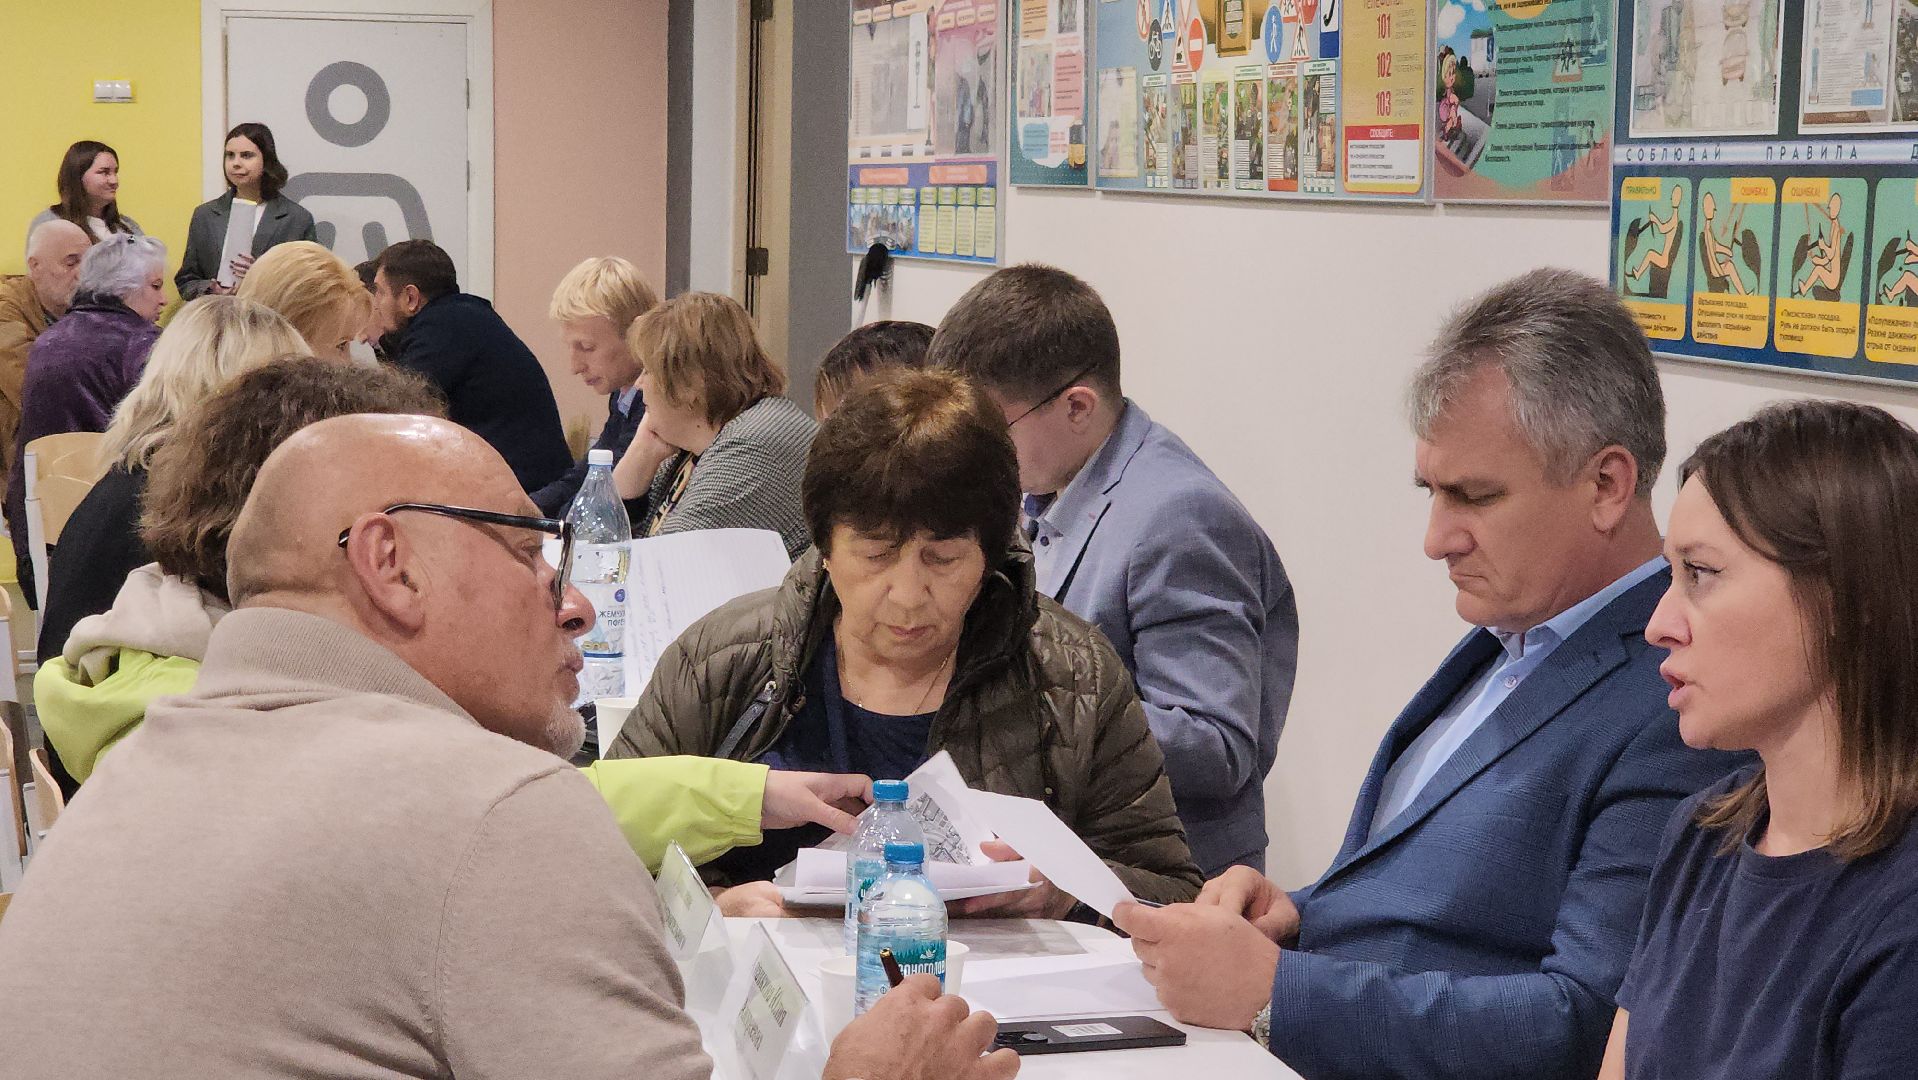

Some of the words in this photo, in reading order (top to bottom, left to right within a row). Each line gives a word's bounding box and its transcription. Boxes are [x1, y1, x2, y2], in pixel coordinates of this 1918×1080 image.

[1376, 13, 1391, 40] 101
[1376, 52, 1392, 78] 102
[1376, 90, 1392, 116] 103
[1626, 144, 1721, 162] СОБЛЮДАЙ
[1766, 145, 1858, 160] ПРАВИЛА
[1741, 186, 1768, 196] ОШИБКА!
[1792, 186, 1821, 197] ОШИБКА!
